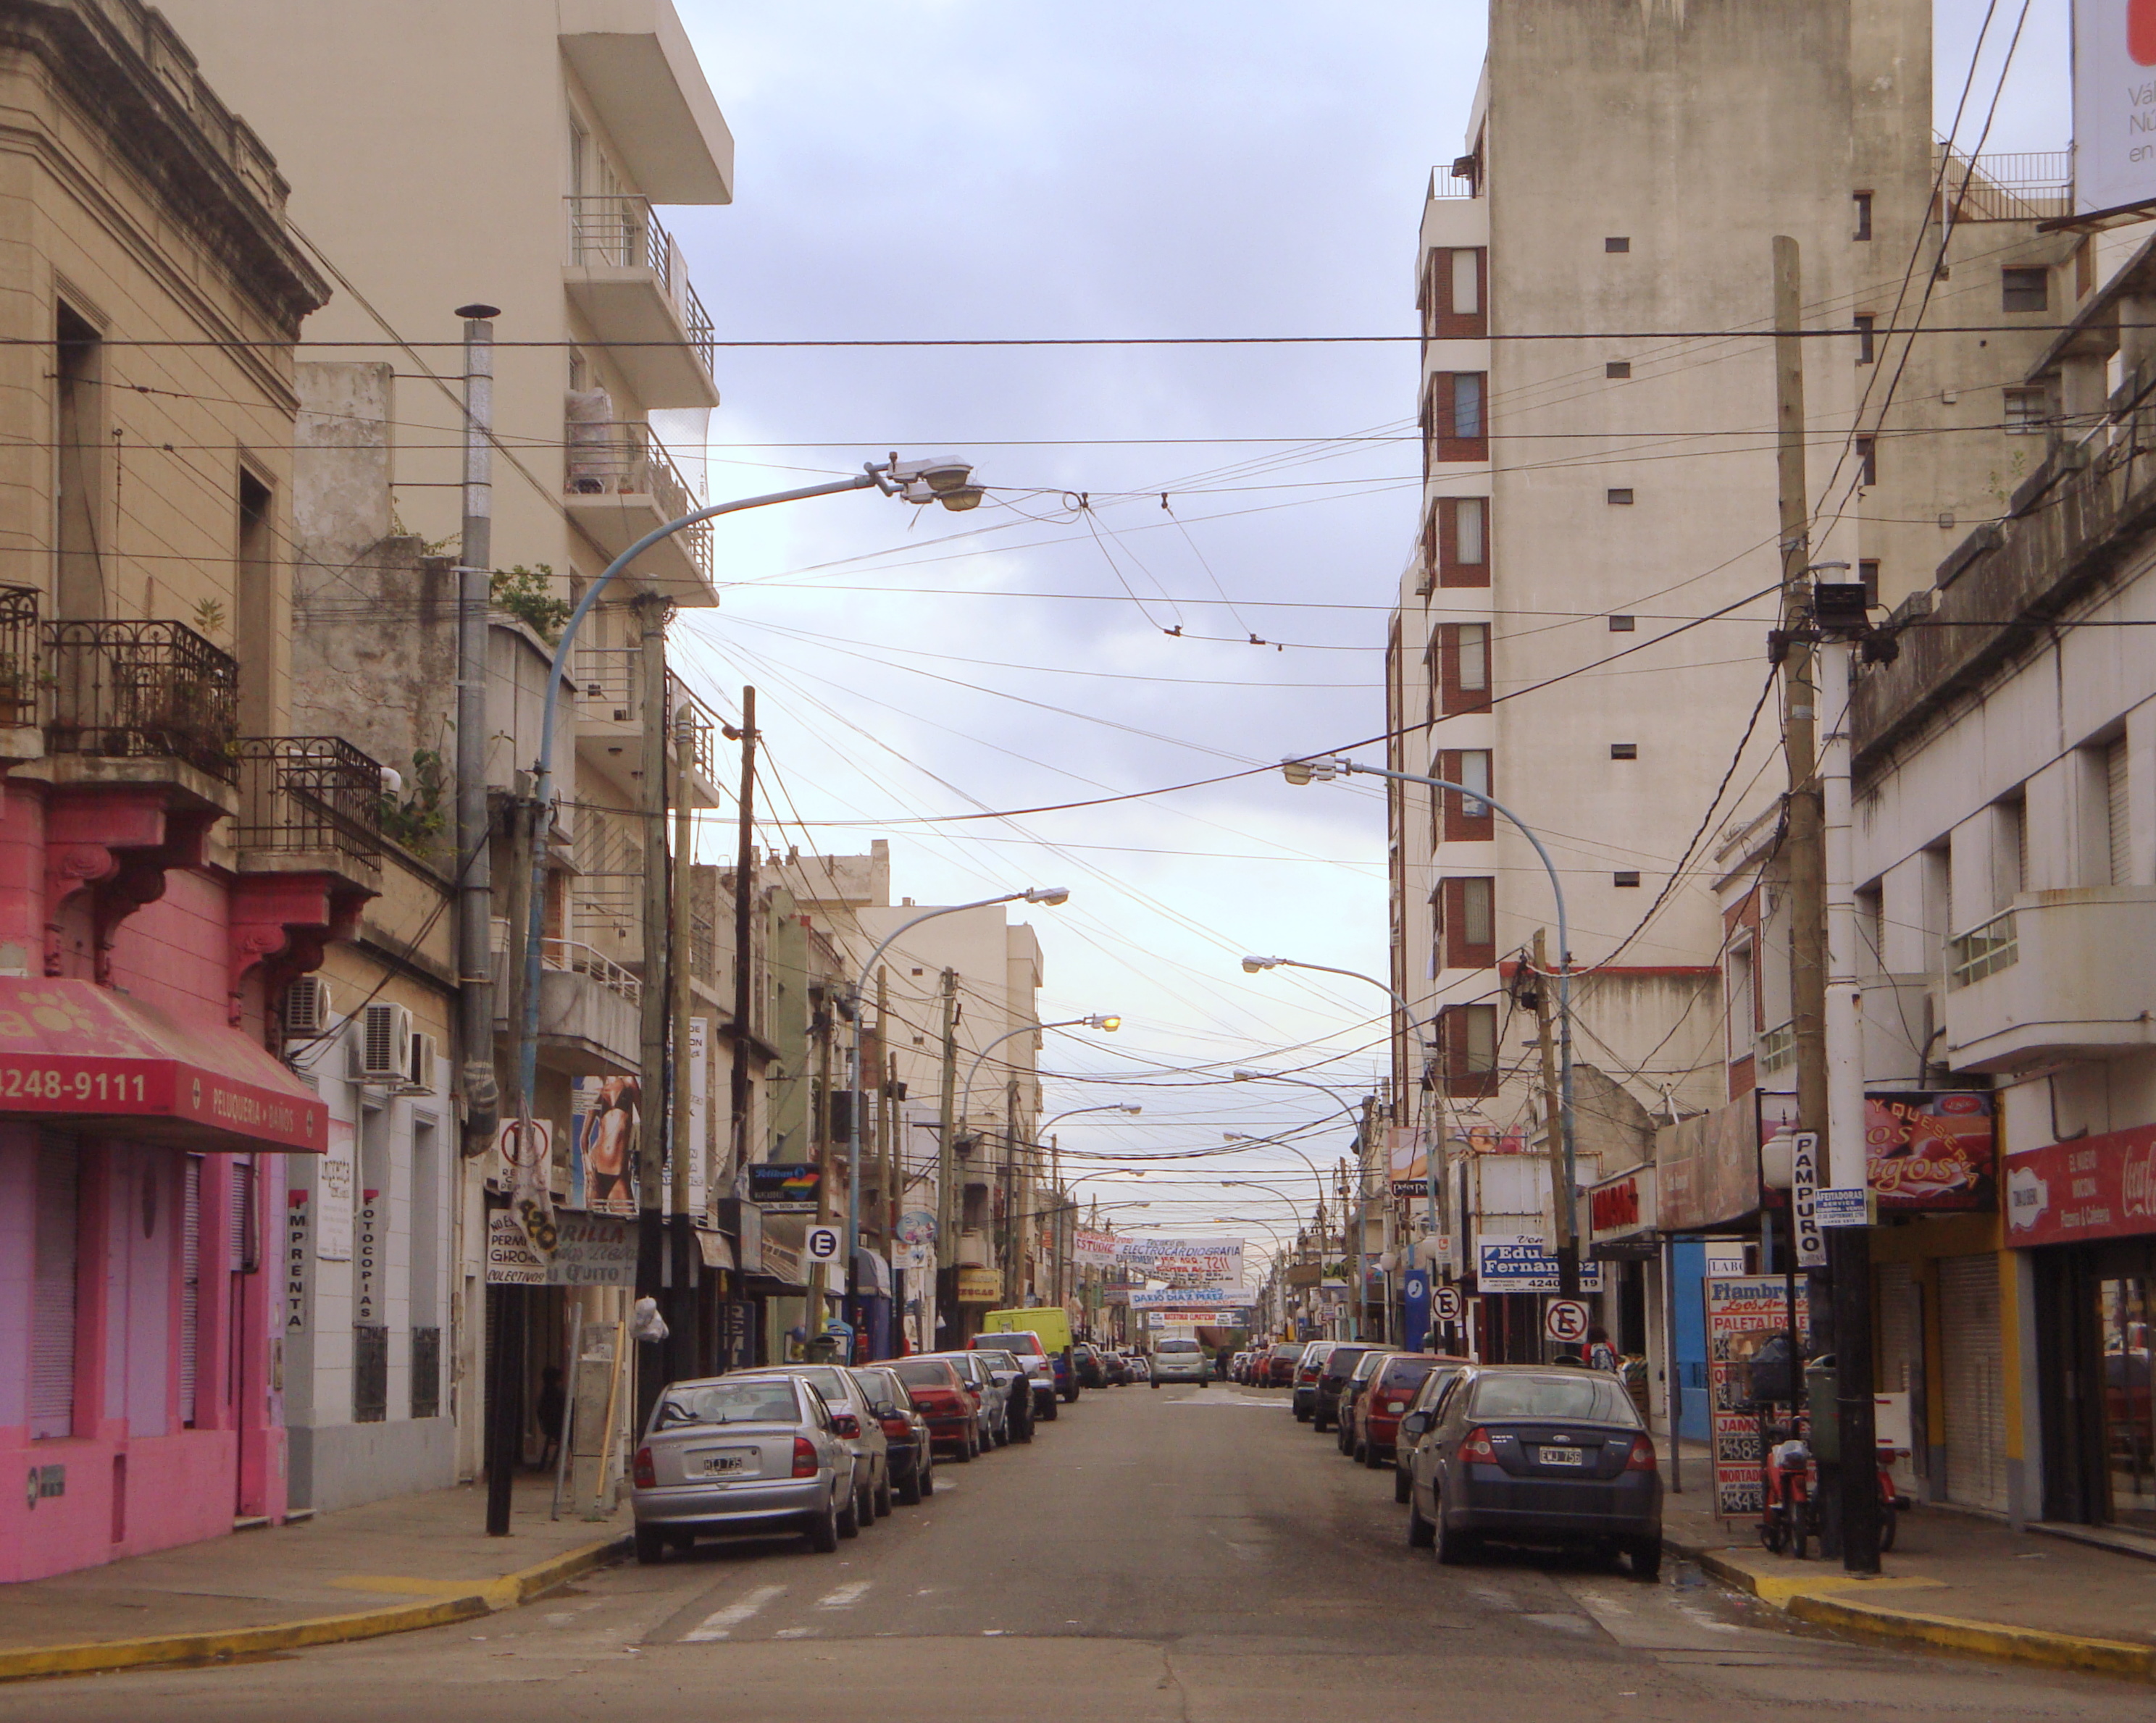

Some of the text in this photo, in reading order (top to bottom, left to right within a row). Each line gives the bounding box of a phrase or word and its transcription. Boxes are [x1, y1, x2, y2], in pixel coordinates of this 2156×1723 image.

[2130, 145, 2154, 162] en
[0, 1068, 143, 1102] 248-9111
[1872, 1099, 1885, 1112] Y
[1795, 1139, 1820, 1252] PAMPURO
[1816, 1190, 1863, 1201] AFEITADORAS
[815, 1234, 832, 1253] E
[288, 1199, 306, 1326] IMPRENTA
[360, 1197, 375, 1317] FOTOCOPIAS
[488, 1270, 545, 1282] COLECTIVOS
[1440, 1294, 1452, 1313] E
[1558, 1307, 1576, 1333] E
[1714, 1317, 1765, 1331] PALETA
[1542, 1451, 1581, 1462] EWJ 756
